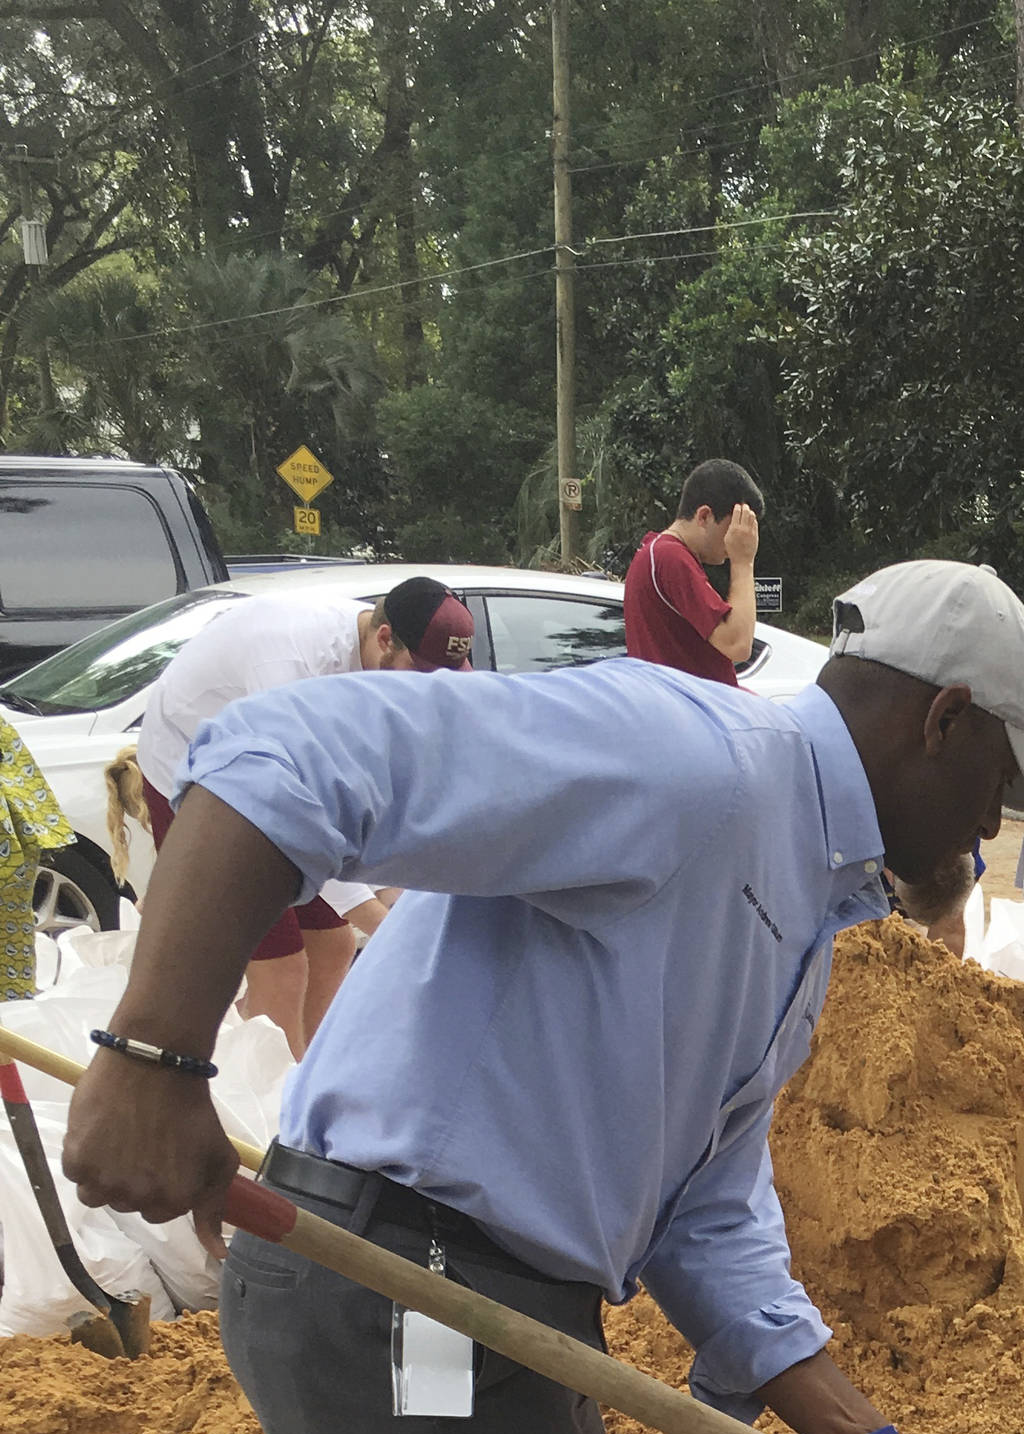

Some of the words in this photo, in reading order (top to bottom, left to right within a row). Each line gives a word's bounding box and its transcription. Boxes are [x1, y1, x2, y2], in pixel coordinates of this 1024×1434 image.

[290, 462, 320, 474] SPEED
[292, 476, 318, 486] HUMP
[298, 511, 316, 524] 20
